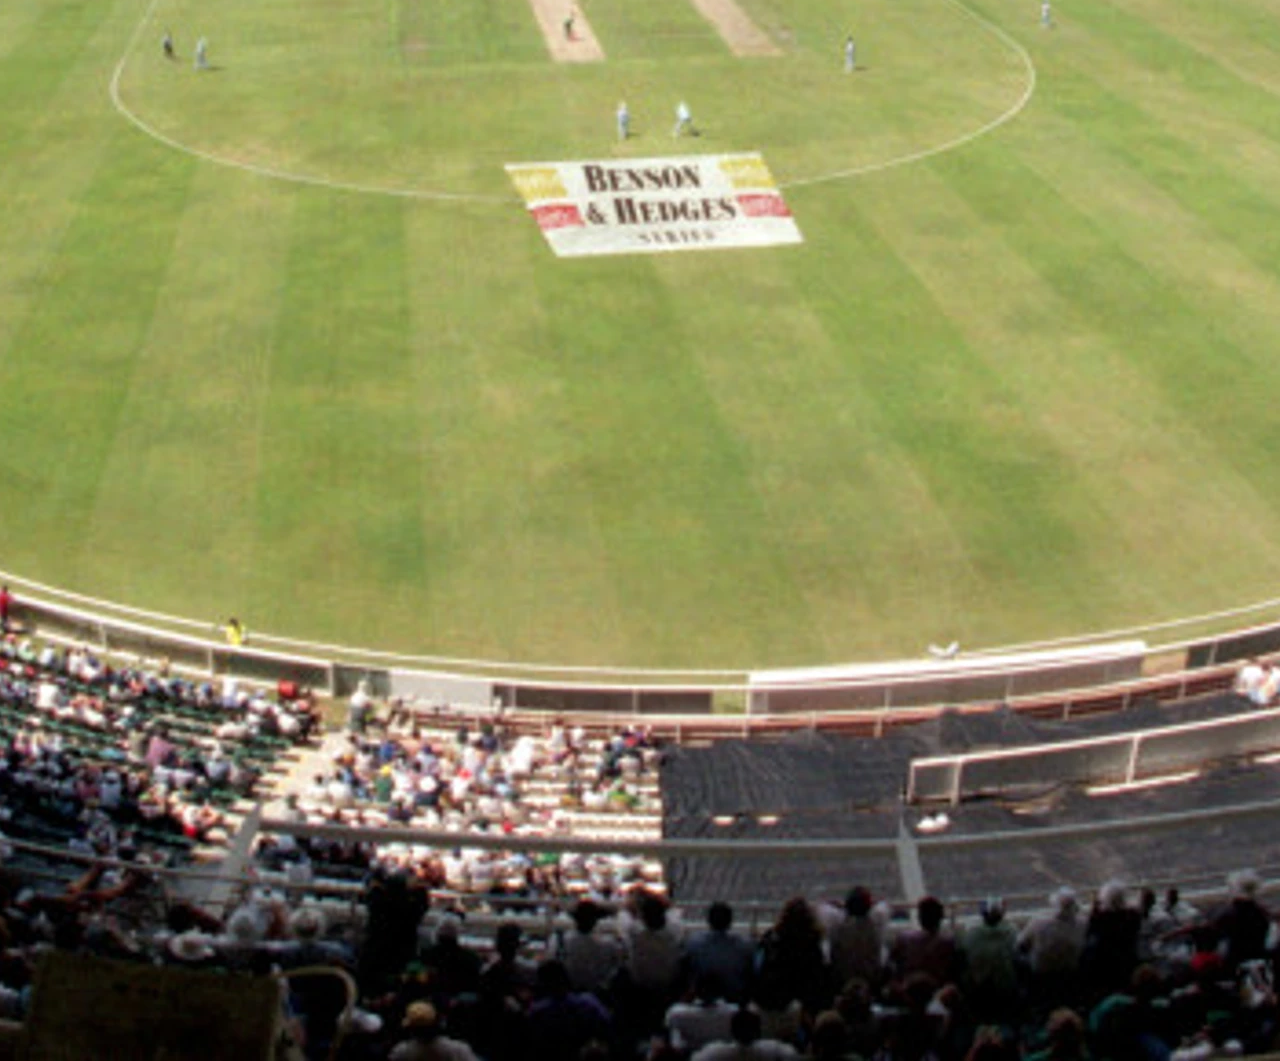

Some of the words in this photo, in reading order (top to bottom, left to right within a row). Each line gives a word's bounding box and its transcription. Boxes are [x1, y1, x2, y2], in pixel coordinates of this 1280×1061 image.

[583, 165, 701, 191] BENSON
[585, 202, 607, 225] &
[613, 197, 737, 225] HEDGES
